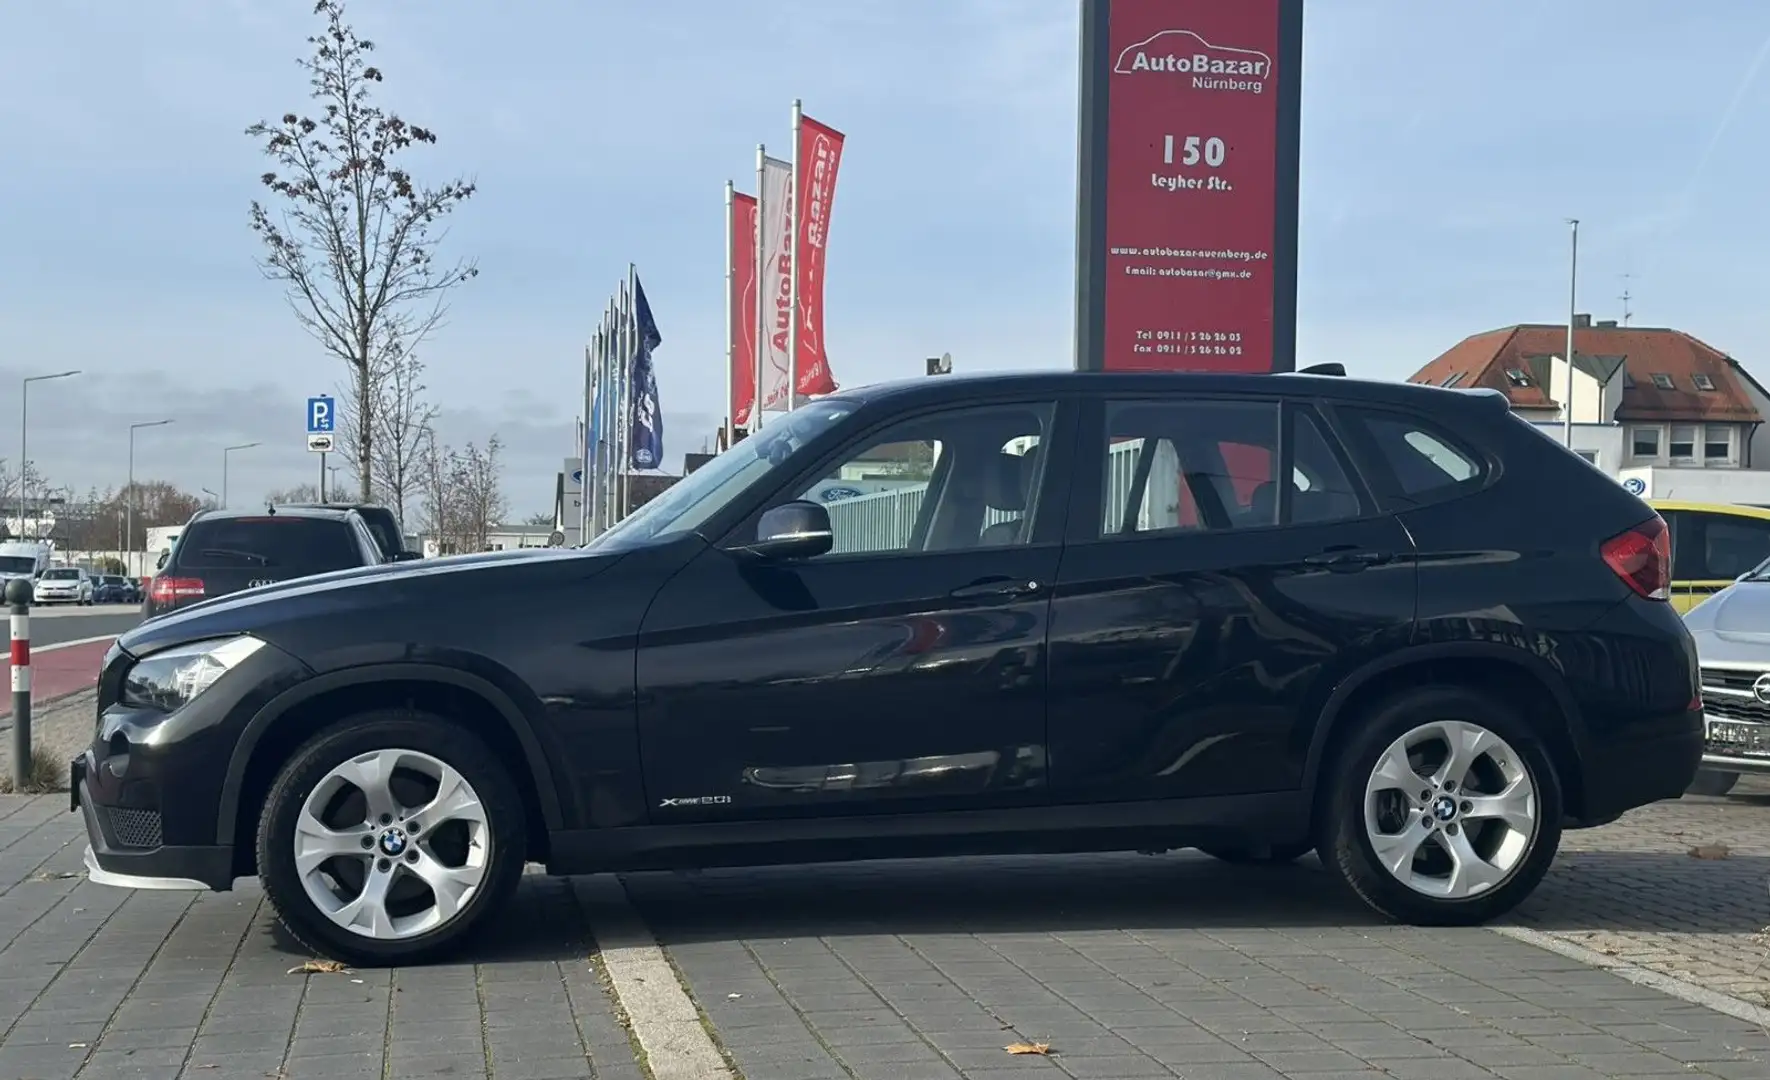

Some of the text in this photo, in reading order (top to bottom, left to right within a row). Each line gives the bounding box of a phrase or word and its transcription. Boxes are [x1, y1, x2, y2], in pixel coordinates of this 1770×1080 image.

[1132, 52, 1264, 75] AutoBazar
[1191, 77, 1262, 94] Nürnberg
[1164, 134, 1225, 167] 150
[1152, 173, 1233, 192] Leyher Str.
[1125, 266, 1252, 280] Email: autobazar@gmx.de
[1136, 331, 1152, 340] Tel
[1157, 331, 1181, 340] 0911
[1134, 344, 1152, 353] Fax
[1157, 344, 1181, 353] 0911
[313, 402, 328, 428] P
